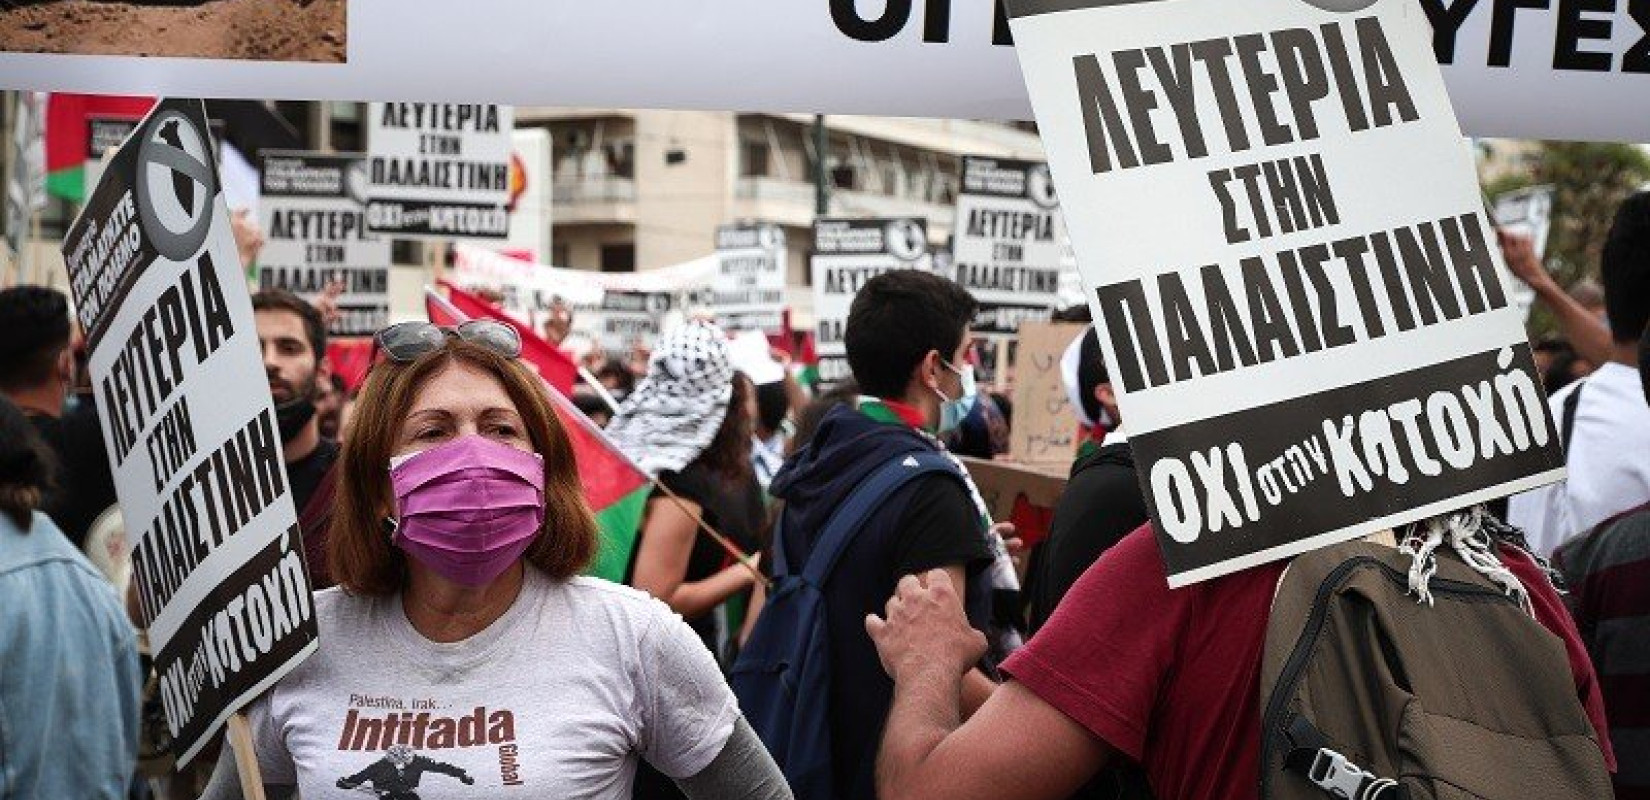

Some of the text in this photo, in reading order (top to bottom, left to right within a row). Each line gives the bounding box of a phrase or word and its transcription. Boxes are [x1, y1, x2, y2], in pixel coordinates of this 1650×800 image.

[382, 102, 499, 133] ΛΕΥΤΕΡΙΑ
[1072, 15, 1420, 174] ΛΕΥΤΕΡΙΑ
[371, 156, 508, 191] ΠΑΛΑΙΣΤΙΝΗ
[1207, 152, 1341, 245] ΣΤΗΝ
[269, 209, 368, 241] ΛΕΥΤΕΡΙ
[967, 209, 1055, 242] ΛΕΥΤΕΡΙΑ
[1096, 212, 1508, 394] ΠΑΛΑΙΣΤΙΝΗ
[102, 248, 236, 468] ΛΕΥΤΕΡΙΑ
[146, 393, 199, 495] ΣΤΗΝ
[1149, 441, 1260, 545] ΟΧΙ
[1256, 433, 1327, 507] στην
[131, 407, 286, 631] ΠΑΛΑΙΣΤΙΝΗ
[337, 706, 517, 751] Intifada
